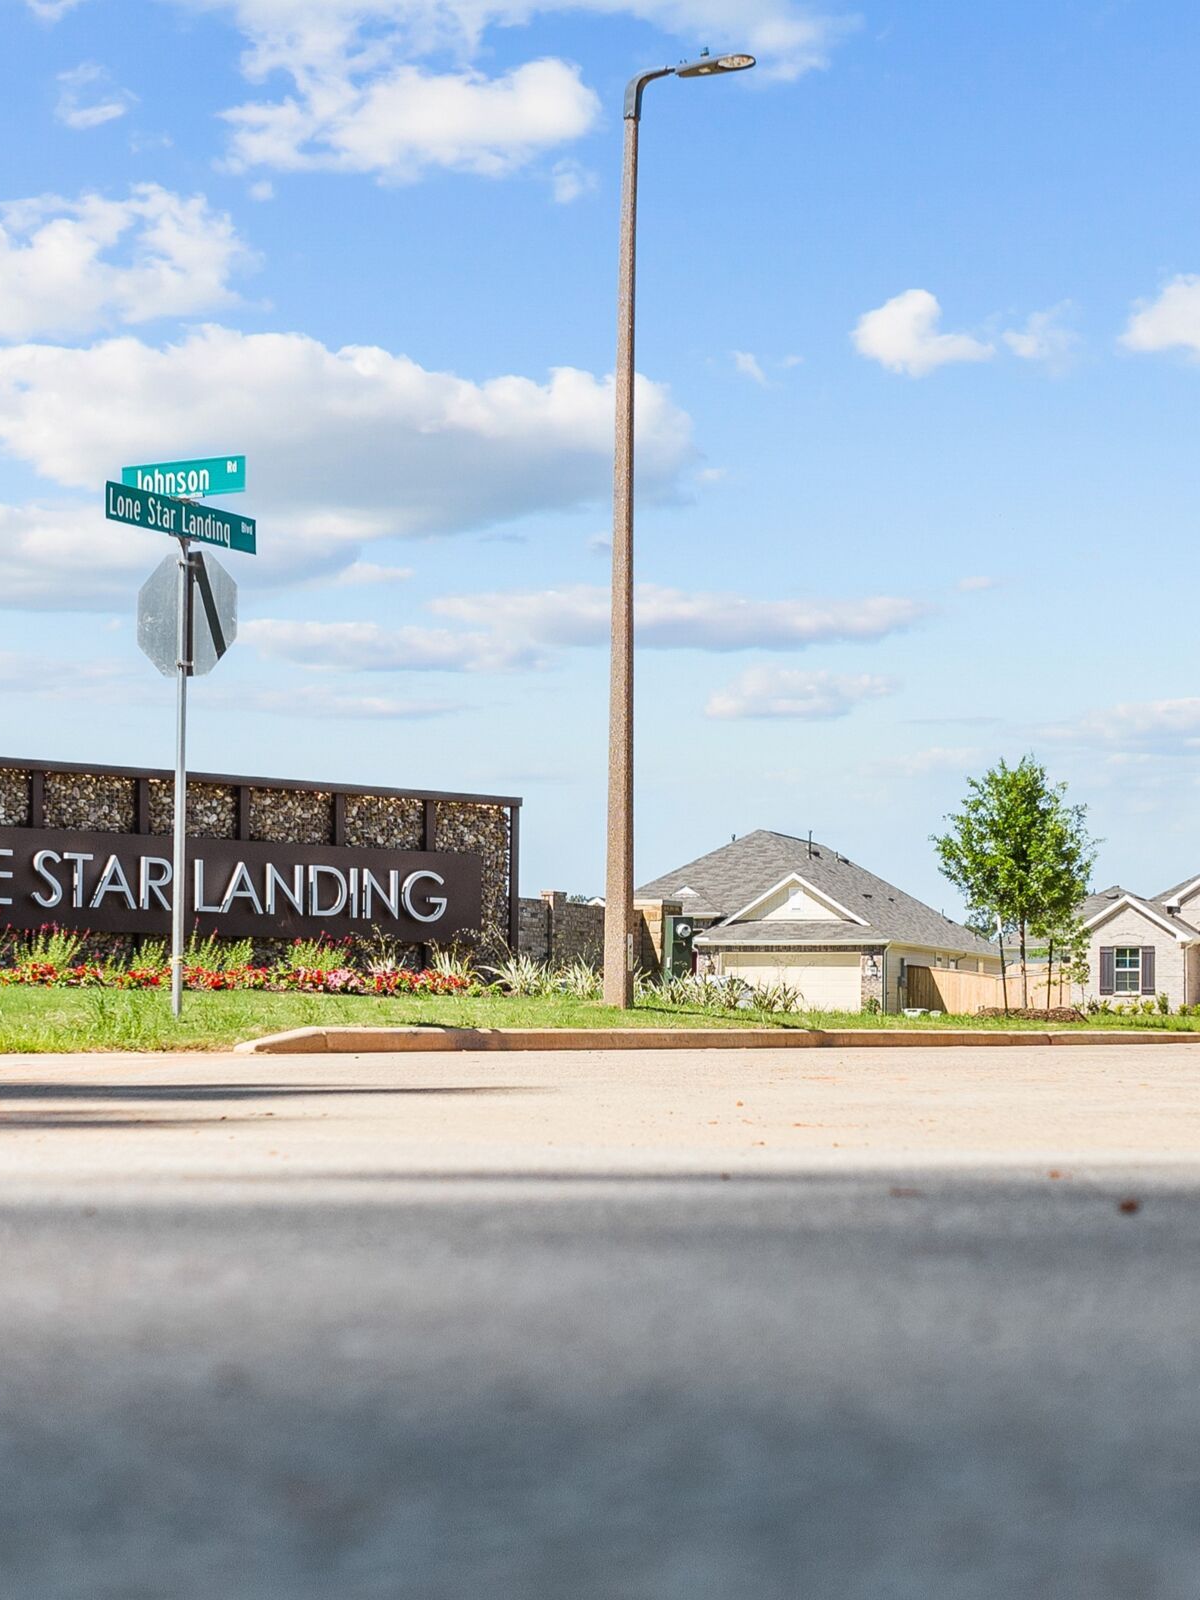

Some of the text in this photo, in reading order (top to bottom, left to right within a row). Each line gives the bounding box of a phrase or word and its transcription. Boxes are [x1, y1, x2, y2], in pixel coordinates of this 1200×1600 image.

[137, 461, 237, 494] Johnson Rd
[109, 487, 141, 521] Lone
[148, 497, 176, 530] Star
[182, 506, 231, 549] Landing
[31, 849, 172, 911] STAR
[194, 859, 448, 922] LANDING
